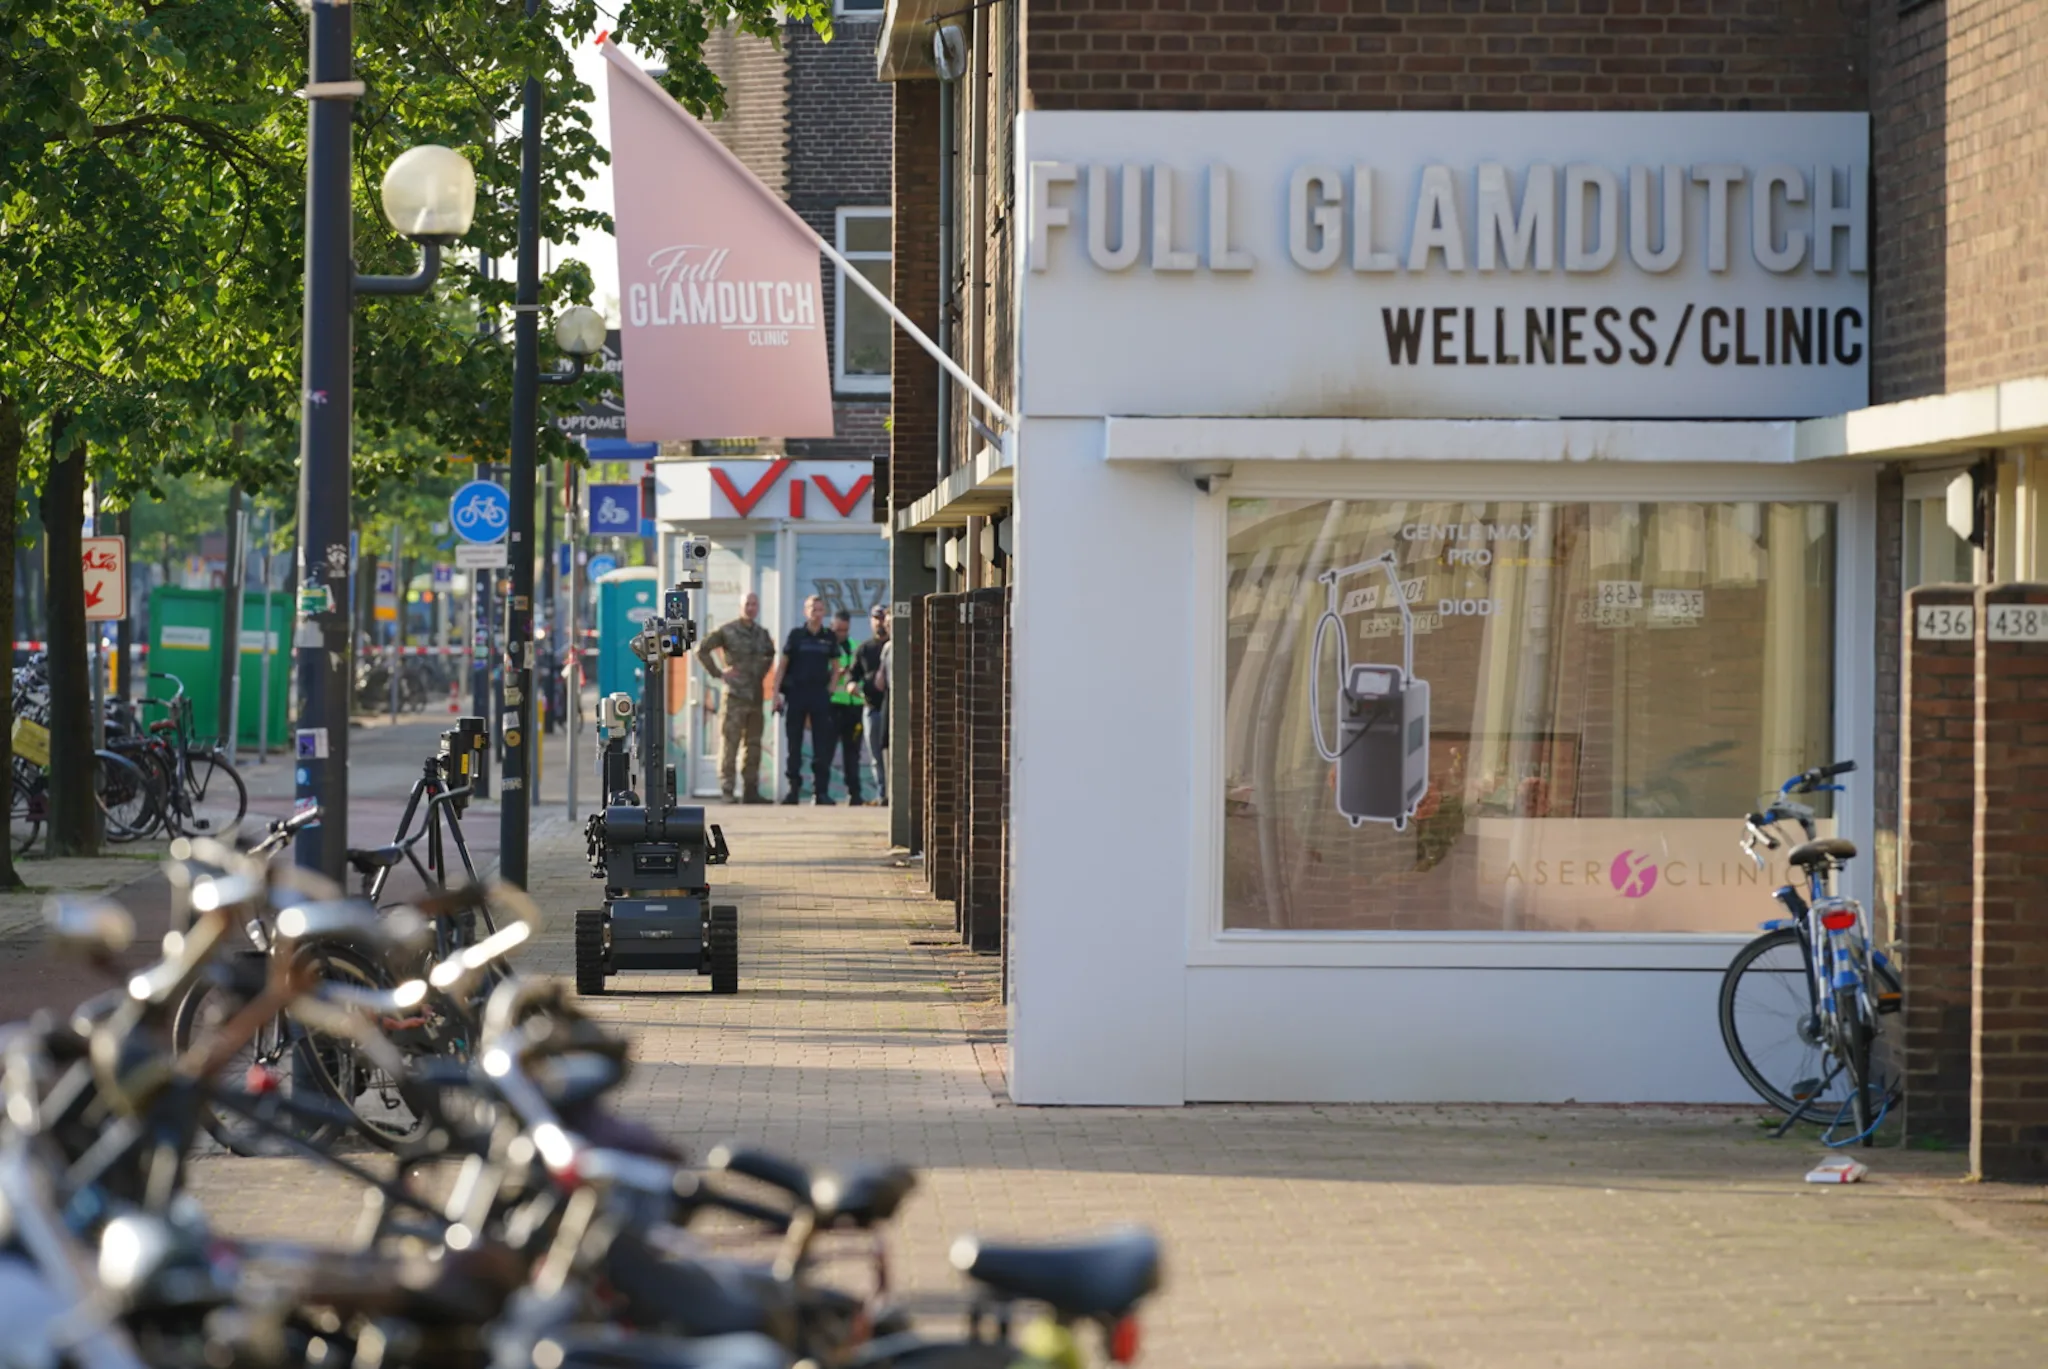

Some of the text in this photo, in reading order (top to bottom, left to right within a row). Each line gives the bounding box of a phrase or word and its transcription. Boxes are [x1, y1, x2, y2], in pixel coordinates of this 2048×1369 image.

[1029, 162, 1868, 273] FULL GLAMDUTCH
[647, 245, 730, 291] Full
[629, 281, 816, 327] GLAMDUTCH
[748, 330, 789, 346] CLINIC
[1382, 303, 1863, 367] WELLNESS/CLINIC
[1402, 524, 1538, 541] GENTLE MAX
[1447, 549, 1493, 566] PRO
[1438, 600, 1505, 616] DIODE
[1923, 610, 1967, 635] 436
[1995, 610, 2038, 635] 438
[1479, 860, 1601, 886] LASER
